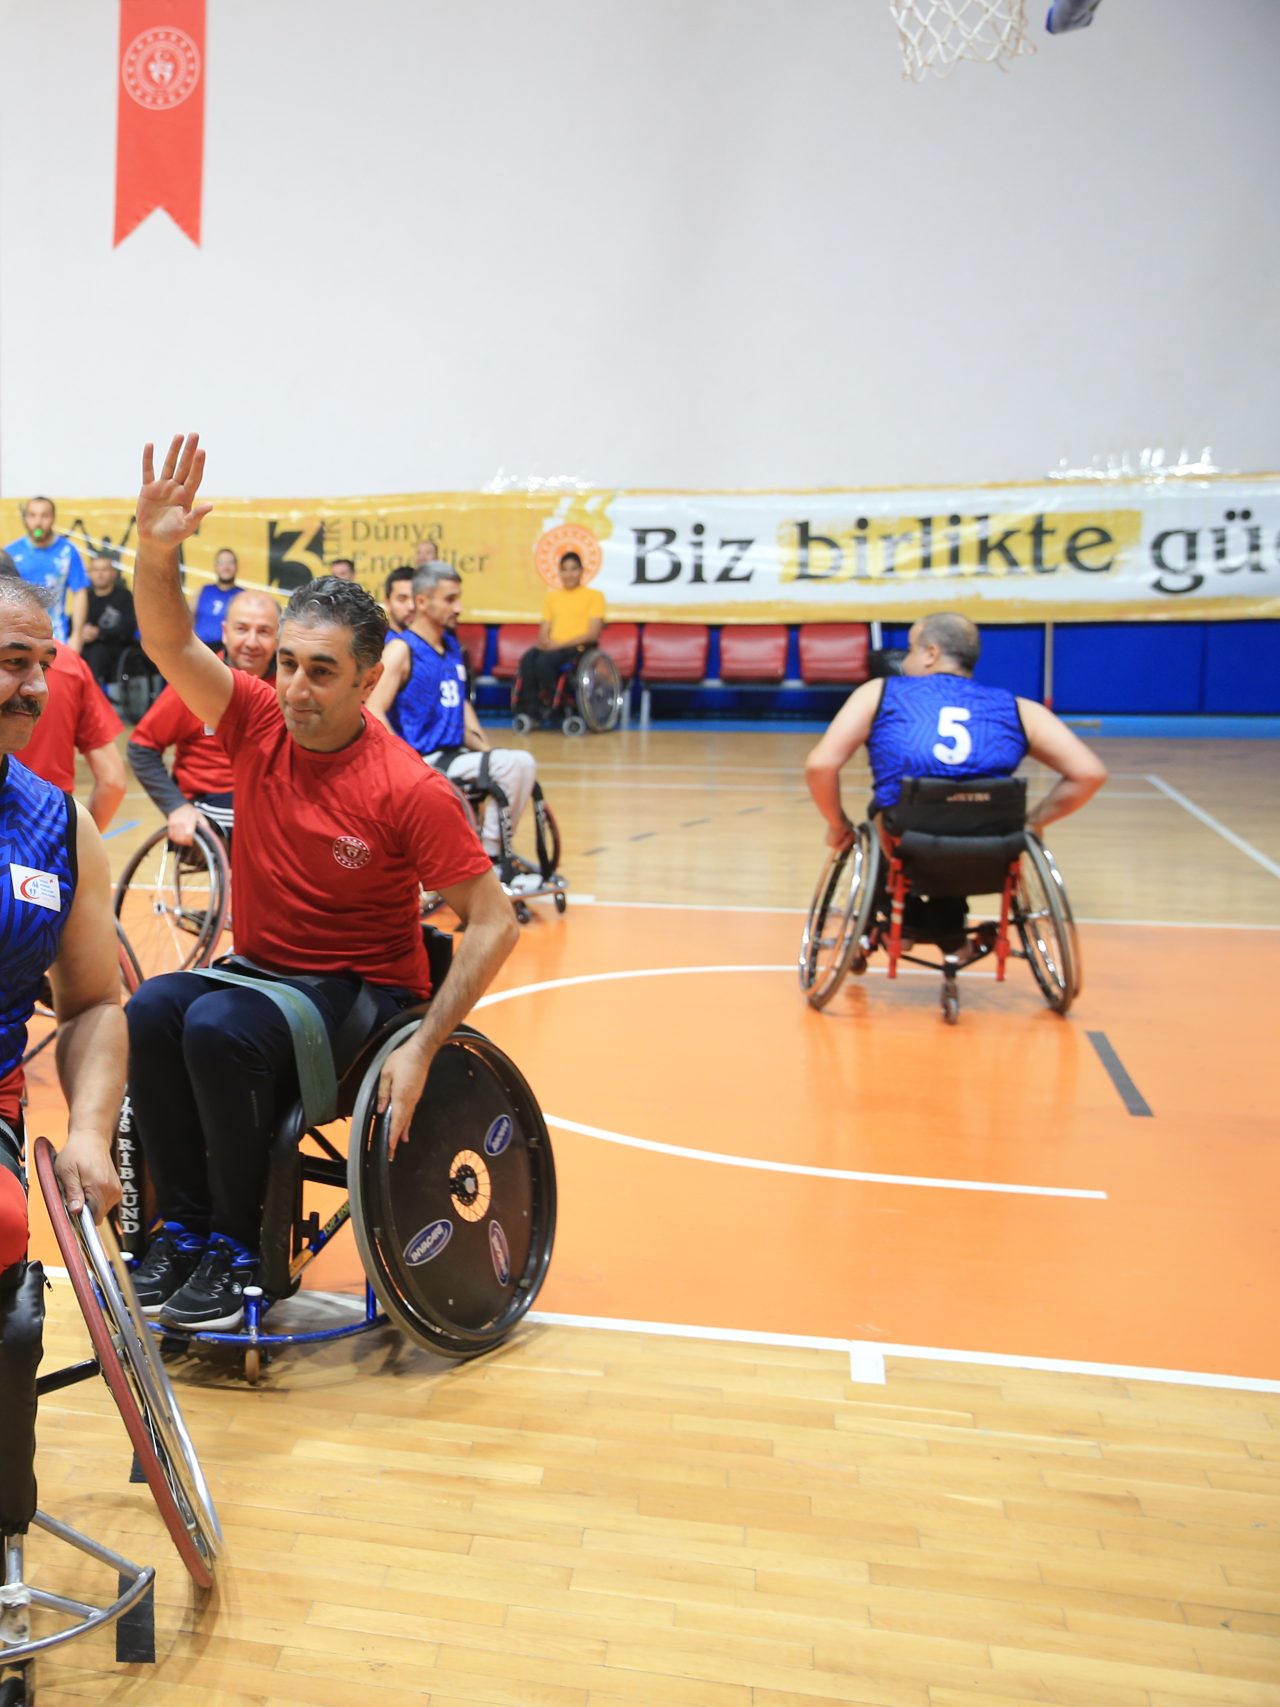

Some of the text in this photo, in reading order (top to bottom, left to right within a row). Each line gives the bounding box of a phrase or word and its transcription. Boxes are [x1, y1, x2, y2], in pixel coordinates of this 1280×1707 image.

[352, 516, 443, 546] Dünya
[630, 509, 1280, 595] Biz birlikte gü
[933, 706, 972, 765] 5
